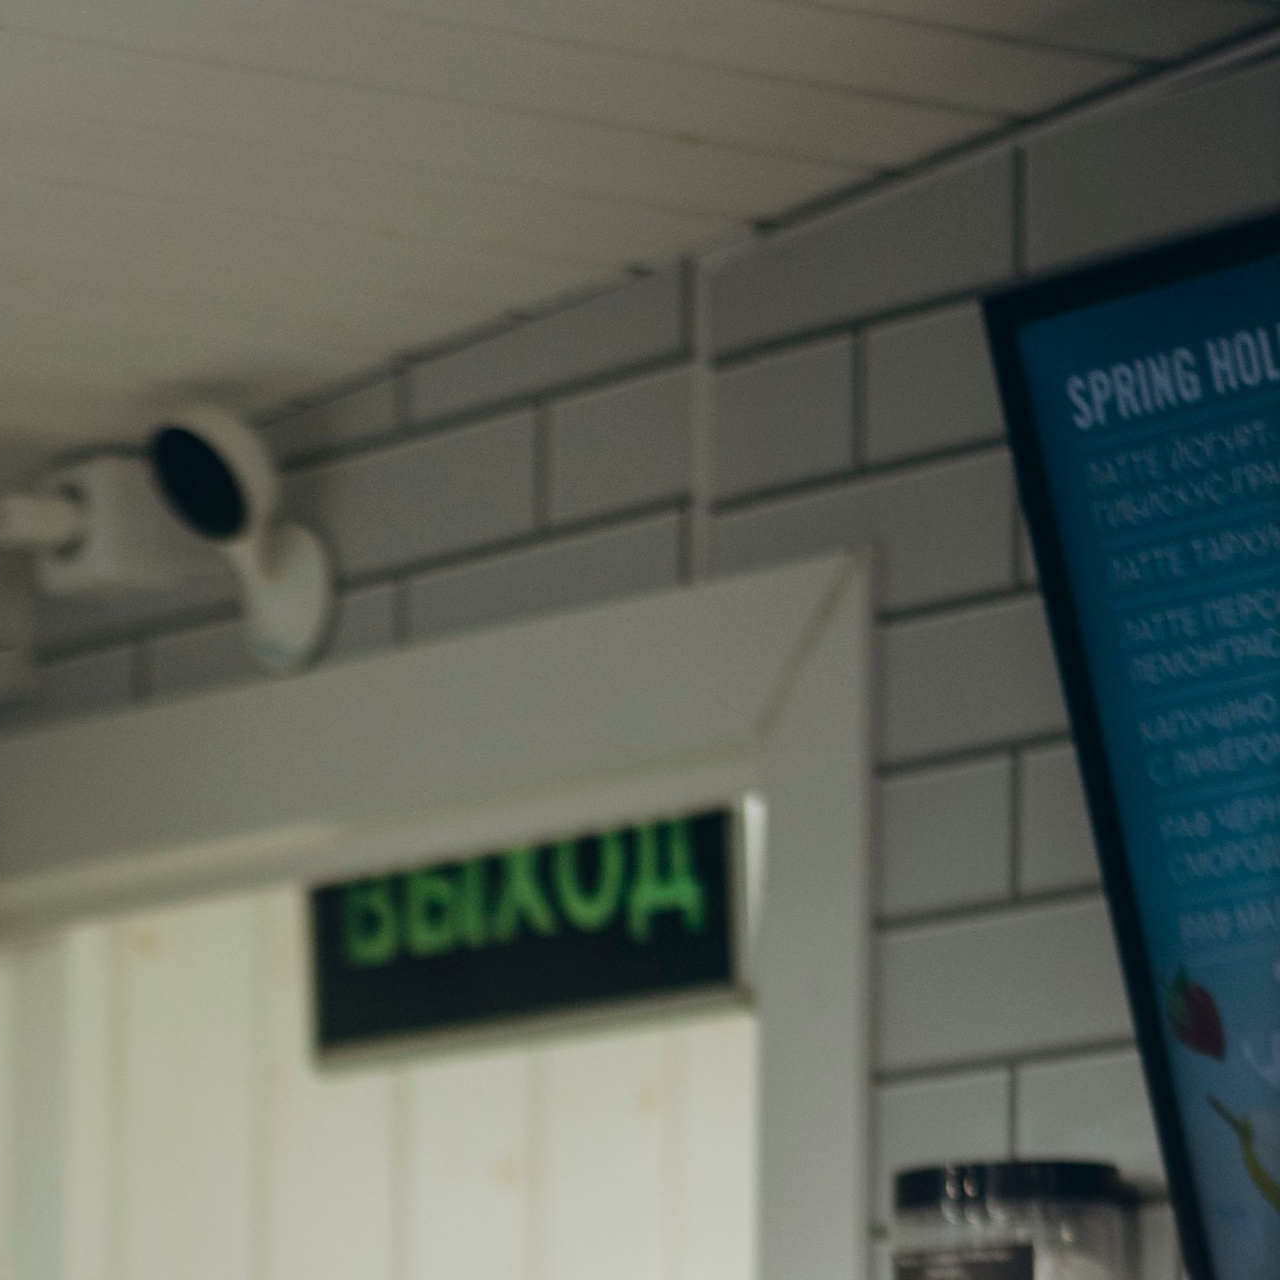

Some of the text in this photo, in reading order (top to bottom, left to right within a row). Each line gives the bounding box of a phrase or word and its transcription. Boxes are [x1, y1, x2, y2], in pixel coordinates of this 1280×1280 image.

[1066, 322, 1280, 430] SPRING HOL
[343, 818, 705, 968] ВЫХОД
